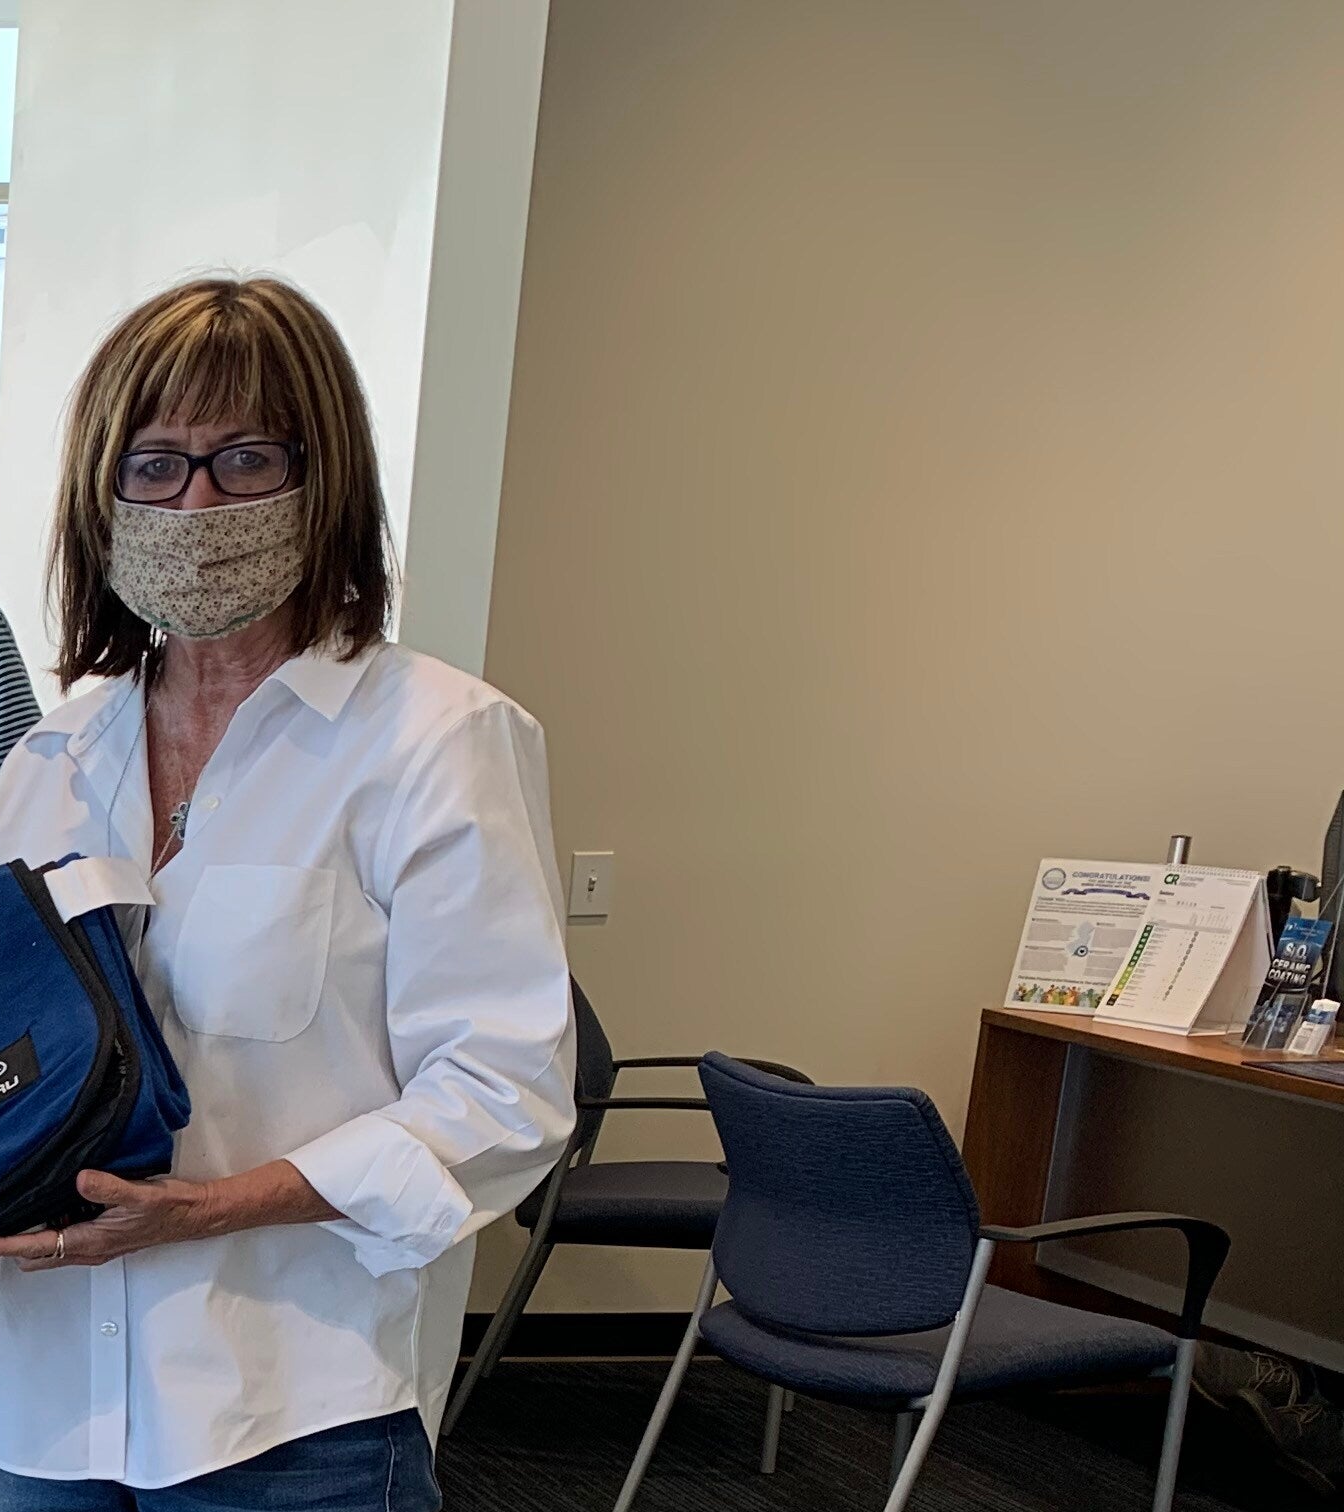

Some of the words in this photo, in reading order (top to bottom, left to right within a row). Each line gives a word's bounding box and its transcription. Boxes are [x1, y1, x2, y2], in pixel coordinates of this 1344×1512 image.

[1164, 873, 1180, 885] CR
[1272, 958, 1311, 973] CERAMIC
[1268, 968, 1308, 985] COATING
